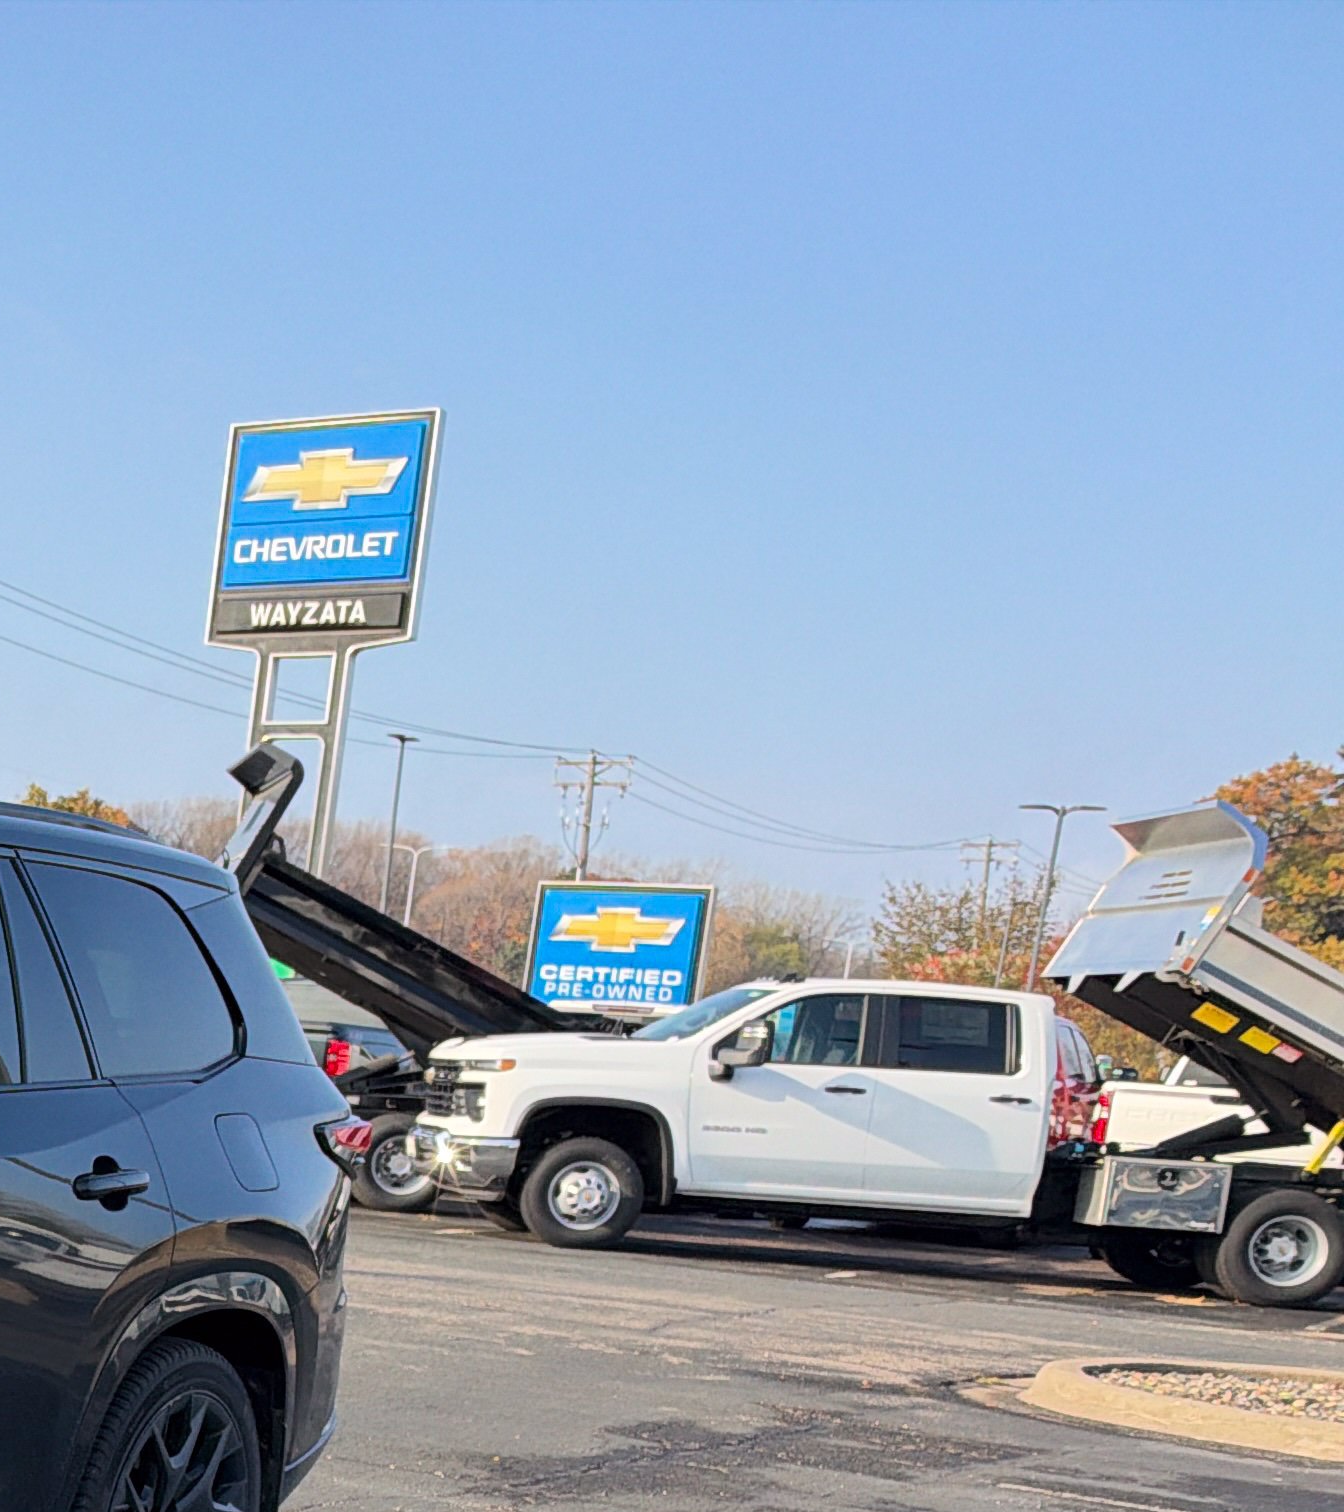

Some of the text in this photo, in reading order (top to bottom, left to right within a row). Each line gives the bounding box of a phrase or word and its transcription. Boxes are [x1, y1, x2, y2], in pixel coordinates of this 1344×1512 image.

[233, 531, 399, 564] CHEVROLET
[250, 600, 367, 627] WAYZATA
[539, 963, 683, 986] CERTIFIED
[543, 981, 673, 1001] PRE-OWNED
